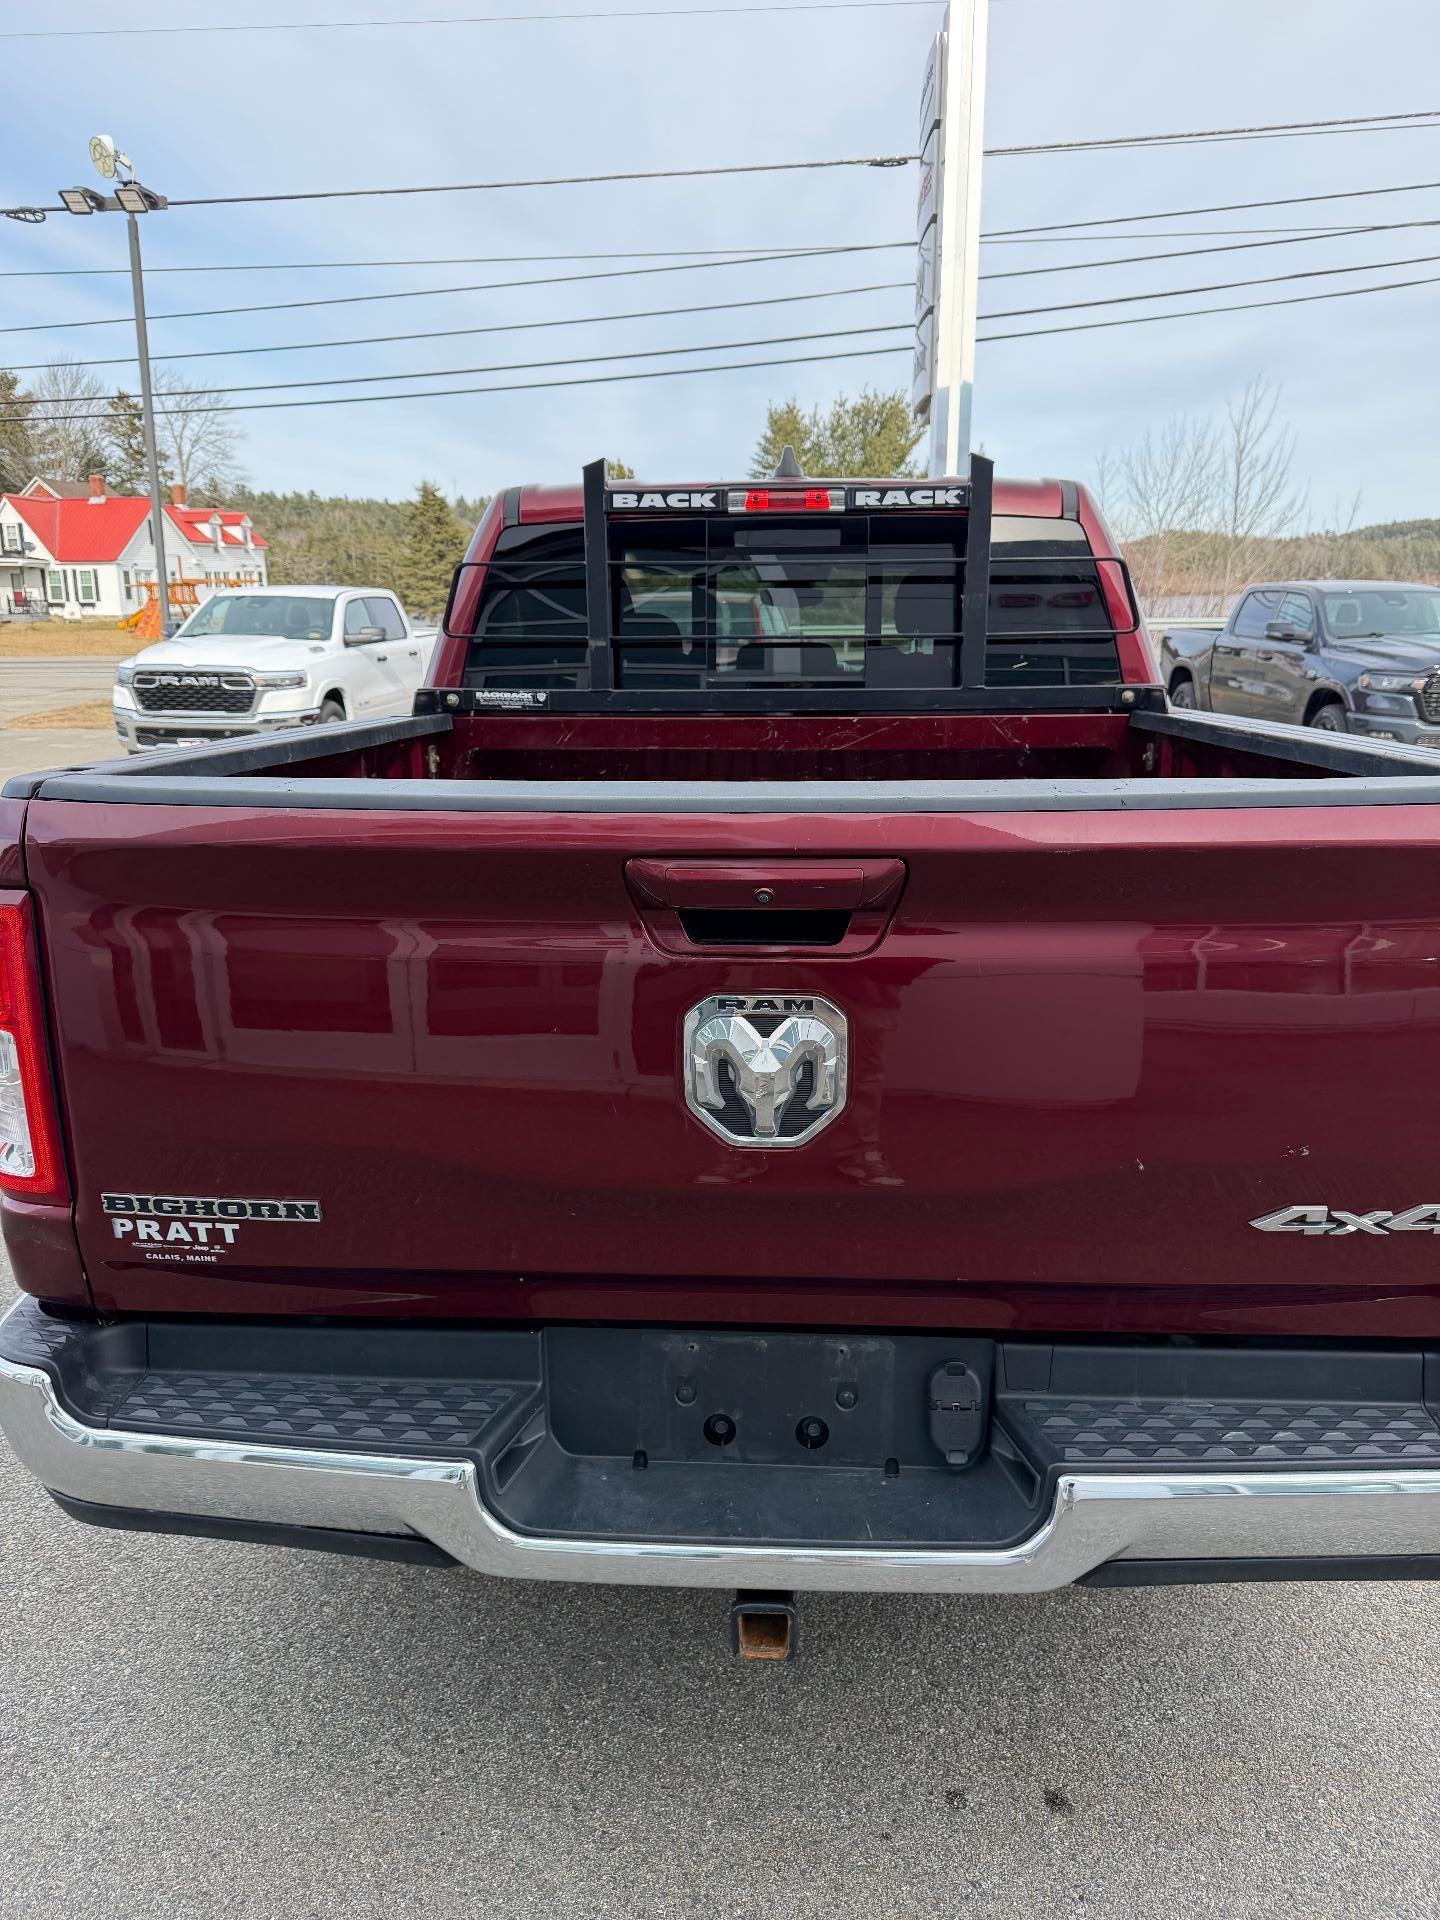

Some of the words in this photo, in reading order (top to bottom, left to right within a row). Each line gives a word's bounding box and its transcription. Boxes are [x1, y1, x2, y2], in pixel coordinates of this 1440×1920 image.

[611, 493, 718, 509] BACK
[854, 489, 961, 507] RACK
[158, 675, 220, 687] RAM
[716, 999, 815, 1012] RAM
[101, 1192, 322, 1223] BIGHORN
[111, 1217, 240, 1244] PRATT
[145, 1253, 184, 1262] CALAIS,
[186, 1254, 218, 1263] MAINE
